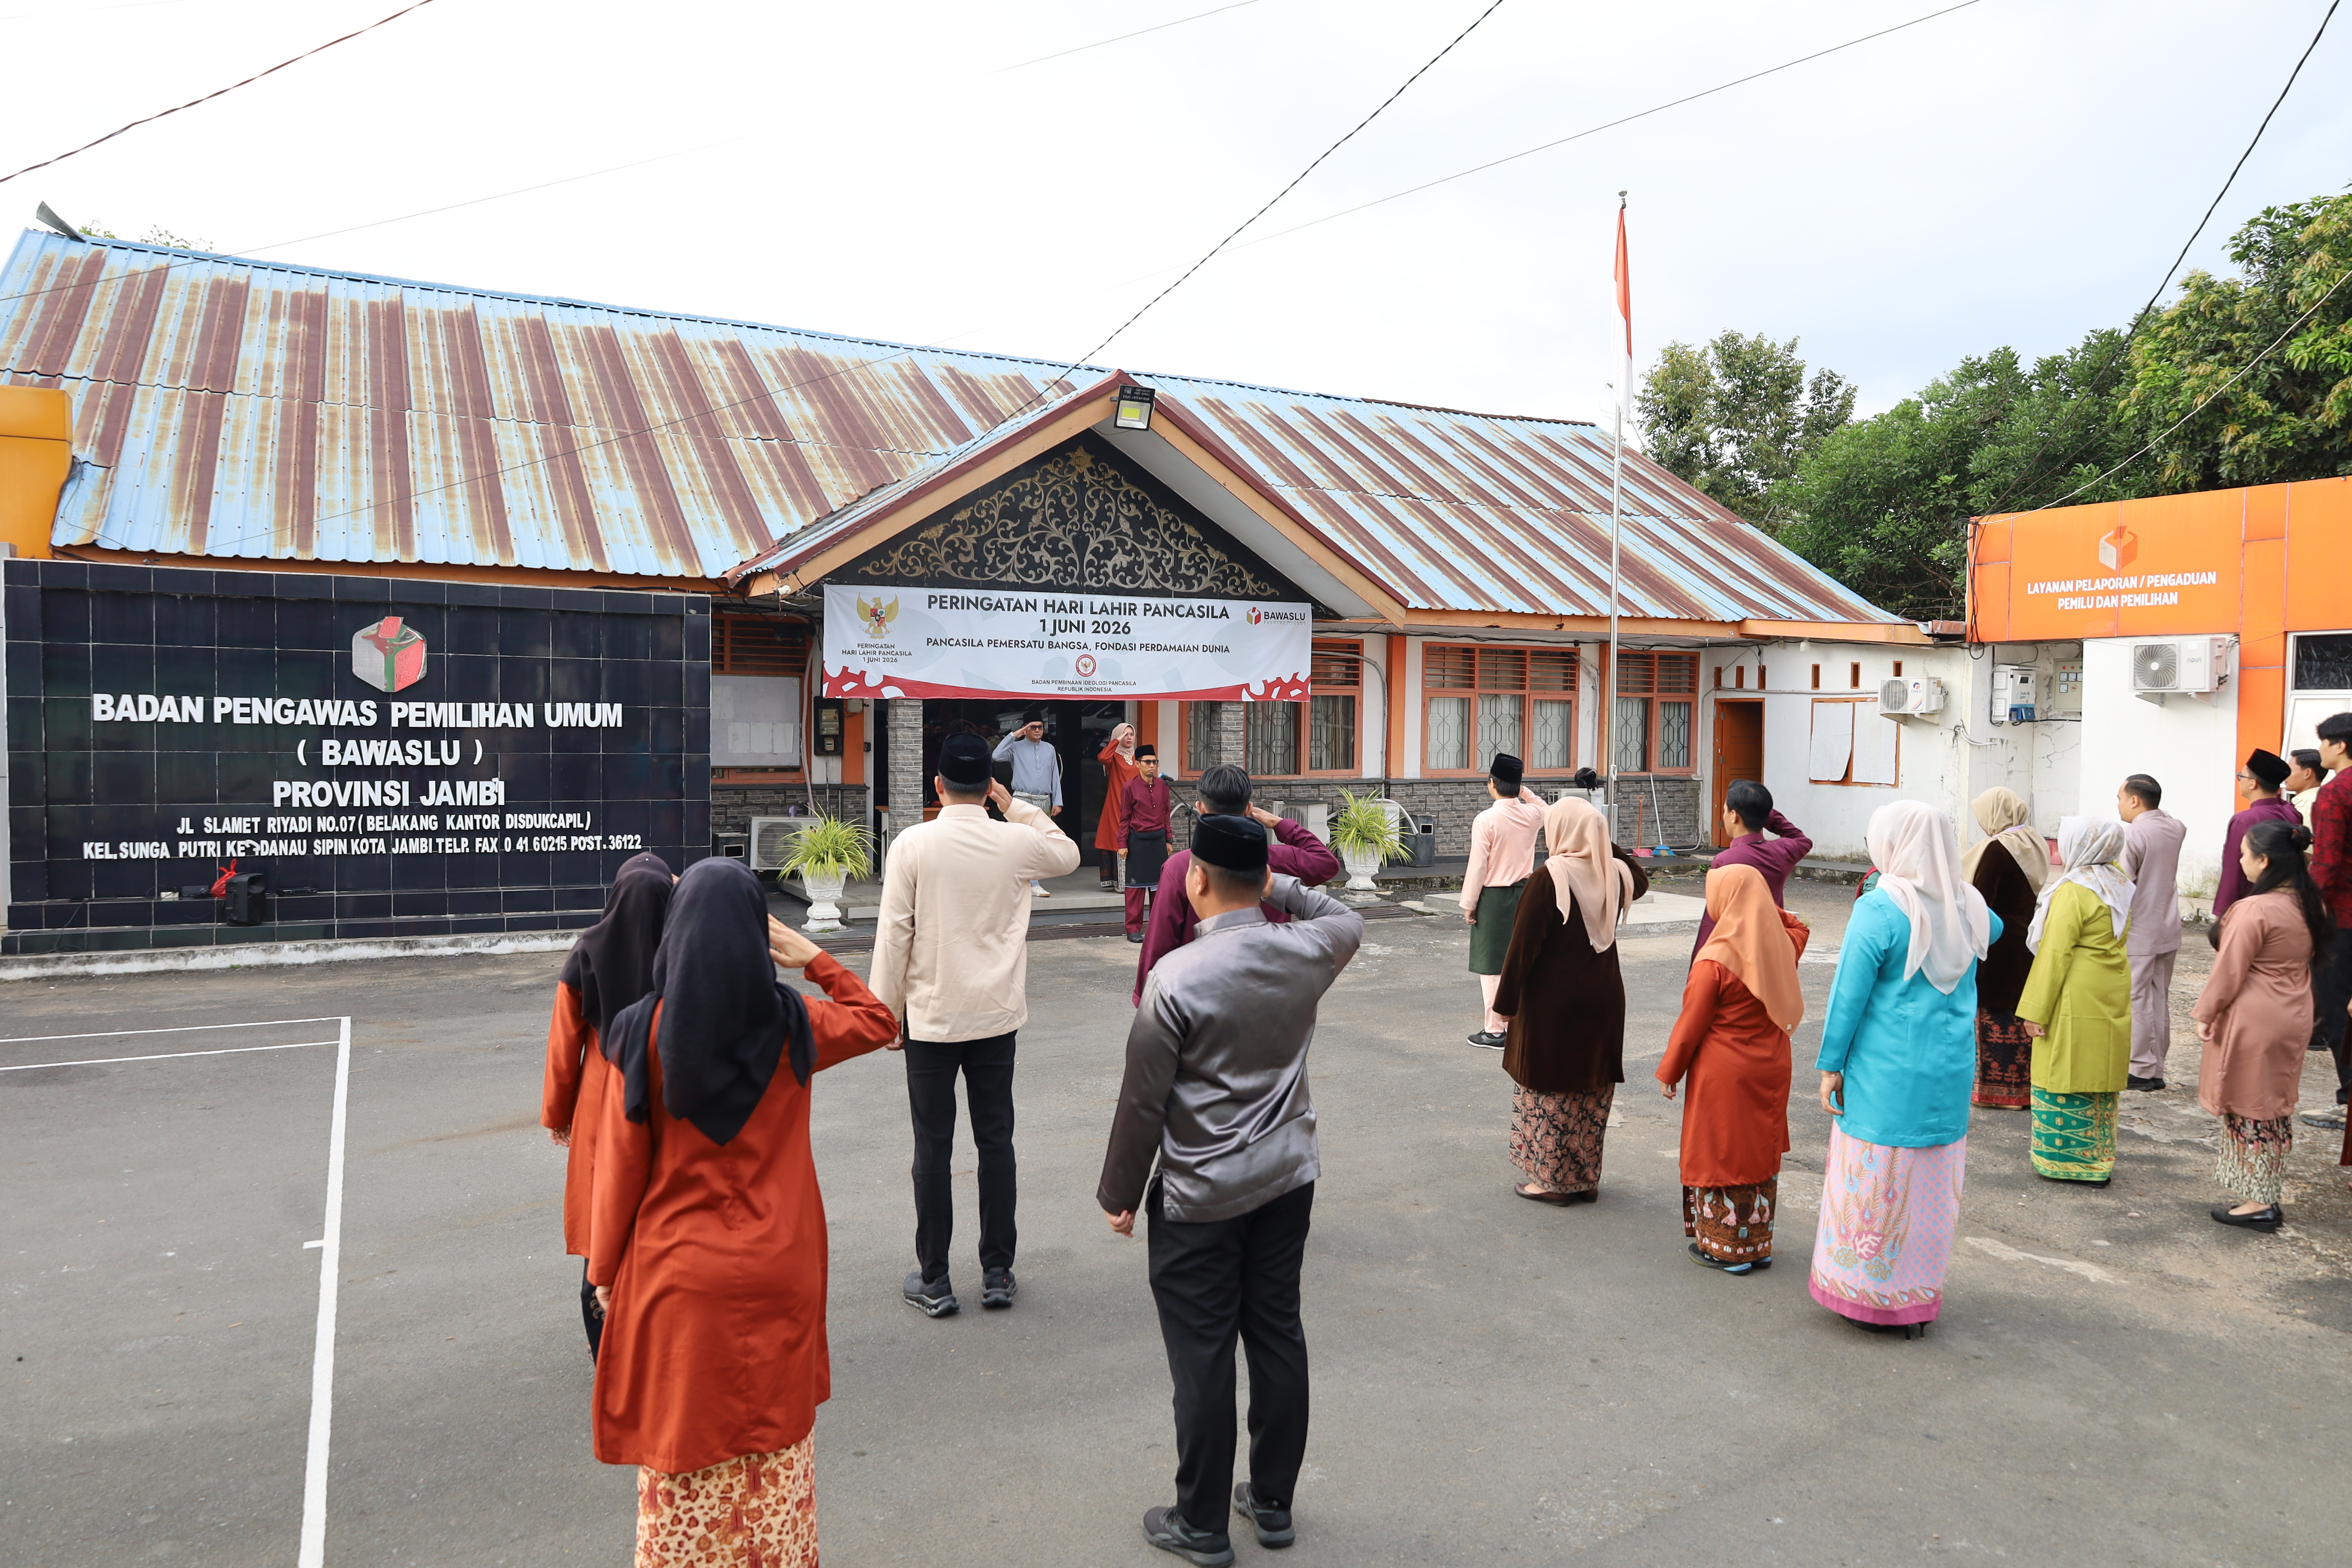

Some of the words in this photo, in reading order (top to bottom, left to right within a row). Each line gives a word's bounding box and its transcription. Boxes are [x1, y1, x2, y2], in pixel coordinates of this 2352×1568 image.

[2027, 580, 2073, 594] LAYANAN
[2075, 576, 2138, 591] PELAPORAN
[2139, 575, 2145, 588] /
[2147, 571, 2216, 588] PENGADUAN
[928, 594, 1037, 613] PERINGATAN
[1044, 599, 1083, 614] HARI
[1090, 600, 1138, 616] LAHIR
[1143, 603, 1230, 619] PANCASILA
[2058, 596, 2094, 610] PEMILU
[2096, 594, 2118, 608] DAN
[2121, 591, 2178, 607] PEMILIHAN
[1264, 611, 1305, 620] BAWASLU
[1040, 619, 1046, 632] 1
[1049, 619, 1085, 636] JUNI
[1091, 620, 1131, 635] 2026
[926, 637, 984, 648] PANCASILA
[987, 639, 1044, 649] PEMERSATU
[1048, 640, 1092, 652] BANGSA,
[1095, 642, 1136, 651] FONDASI
[1139, 643, 1199, 652] PERDAMAIAN
[1202, 645, 1230, 653] DUNIA
[93, 694, 204, 723] BADAN
[214, 697, 377, 726] PENGAWAS
[391, 702, 534, 728] PEMILIHAN
[544, 703, 622, 727] UMUM
[322, 740, 460, 766] BAWASLU
[273, 781, 409, 807] PROVINSI
[420, 780, 505, 806] JAMBI
[177, 818, 194, 834] JL
[204, 817, 260, 833] SLAMET
[267, 816, 312, 833] RIYADI
[317, 816, 356, 832] NO.07
[446, 814, 500, 830] KANTOR
[179, 841, 221, 858] PUTRI
[314, 838, 347, 855] SIPIN
[351, 838, 386, 855] KOTA
[392, 838, 432, 854] JAMBI
[436, 838, 469, 853] TELP.
[475, 837, 498, 853] FAX
[504, 837, 511, 852] 0
[516, 837, 528, 852] 41
[533, 836, 567, 851] 60215
